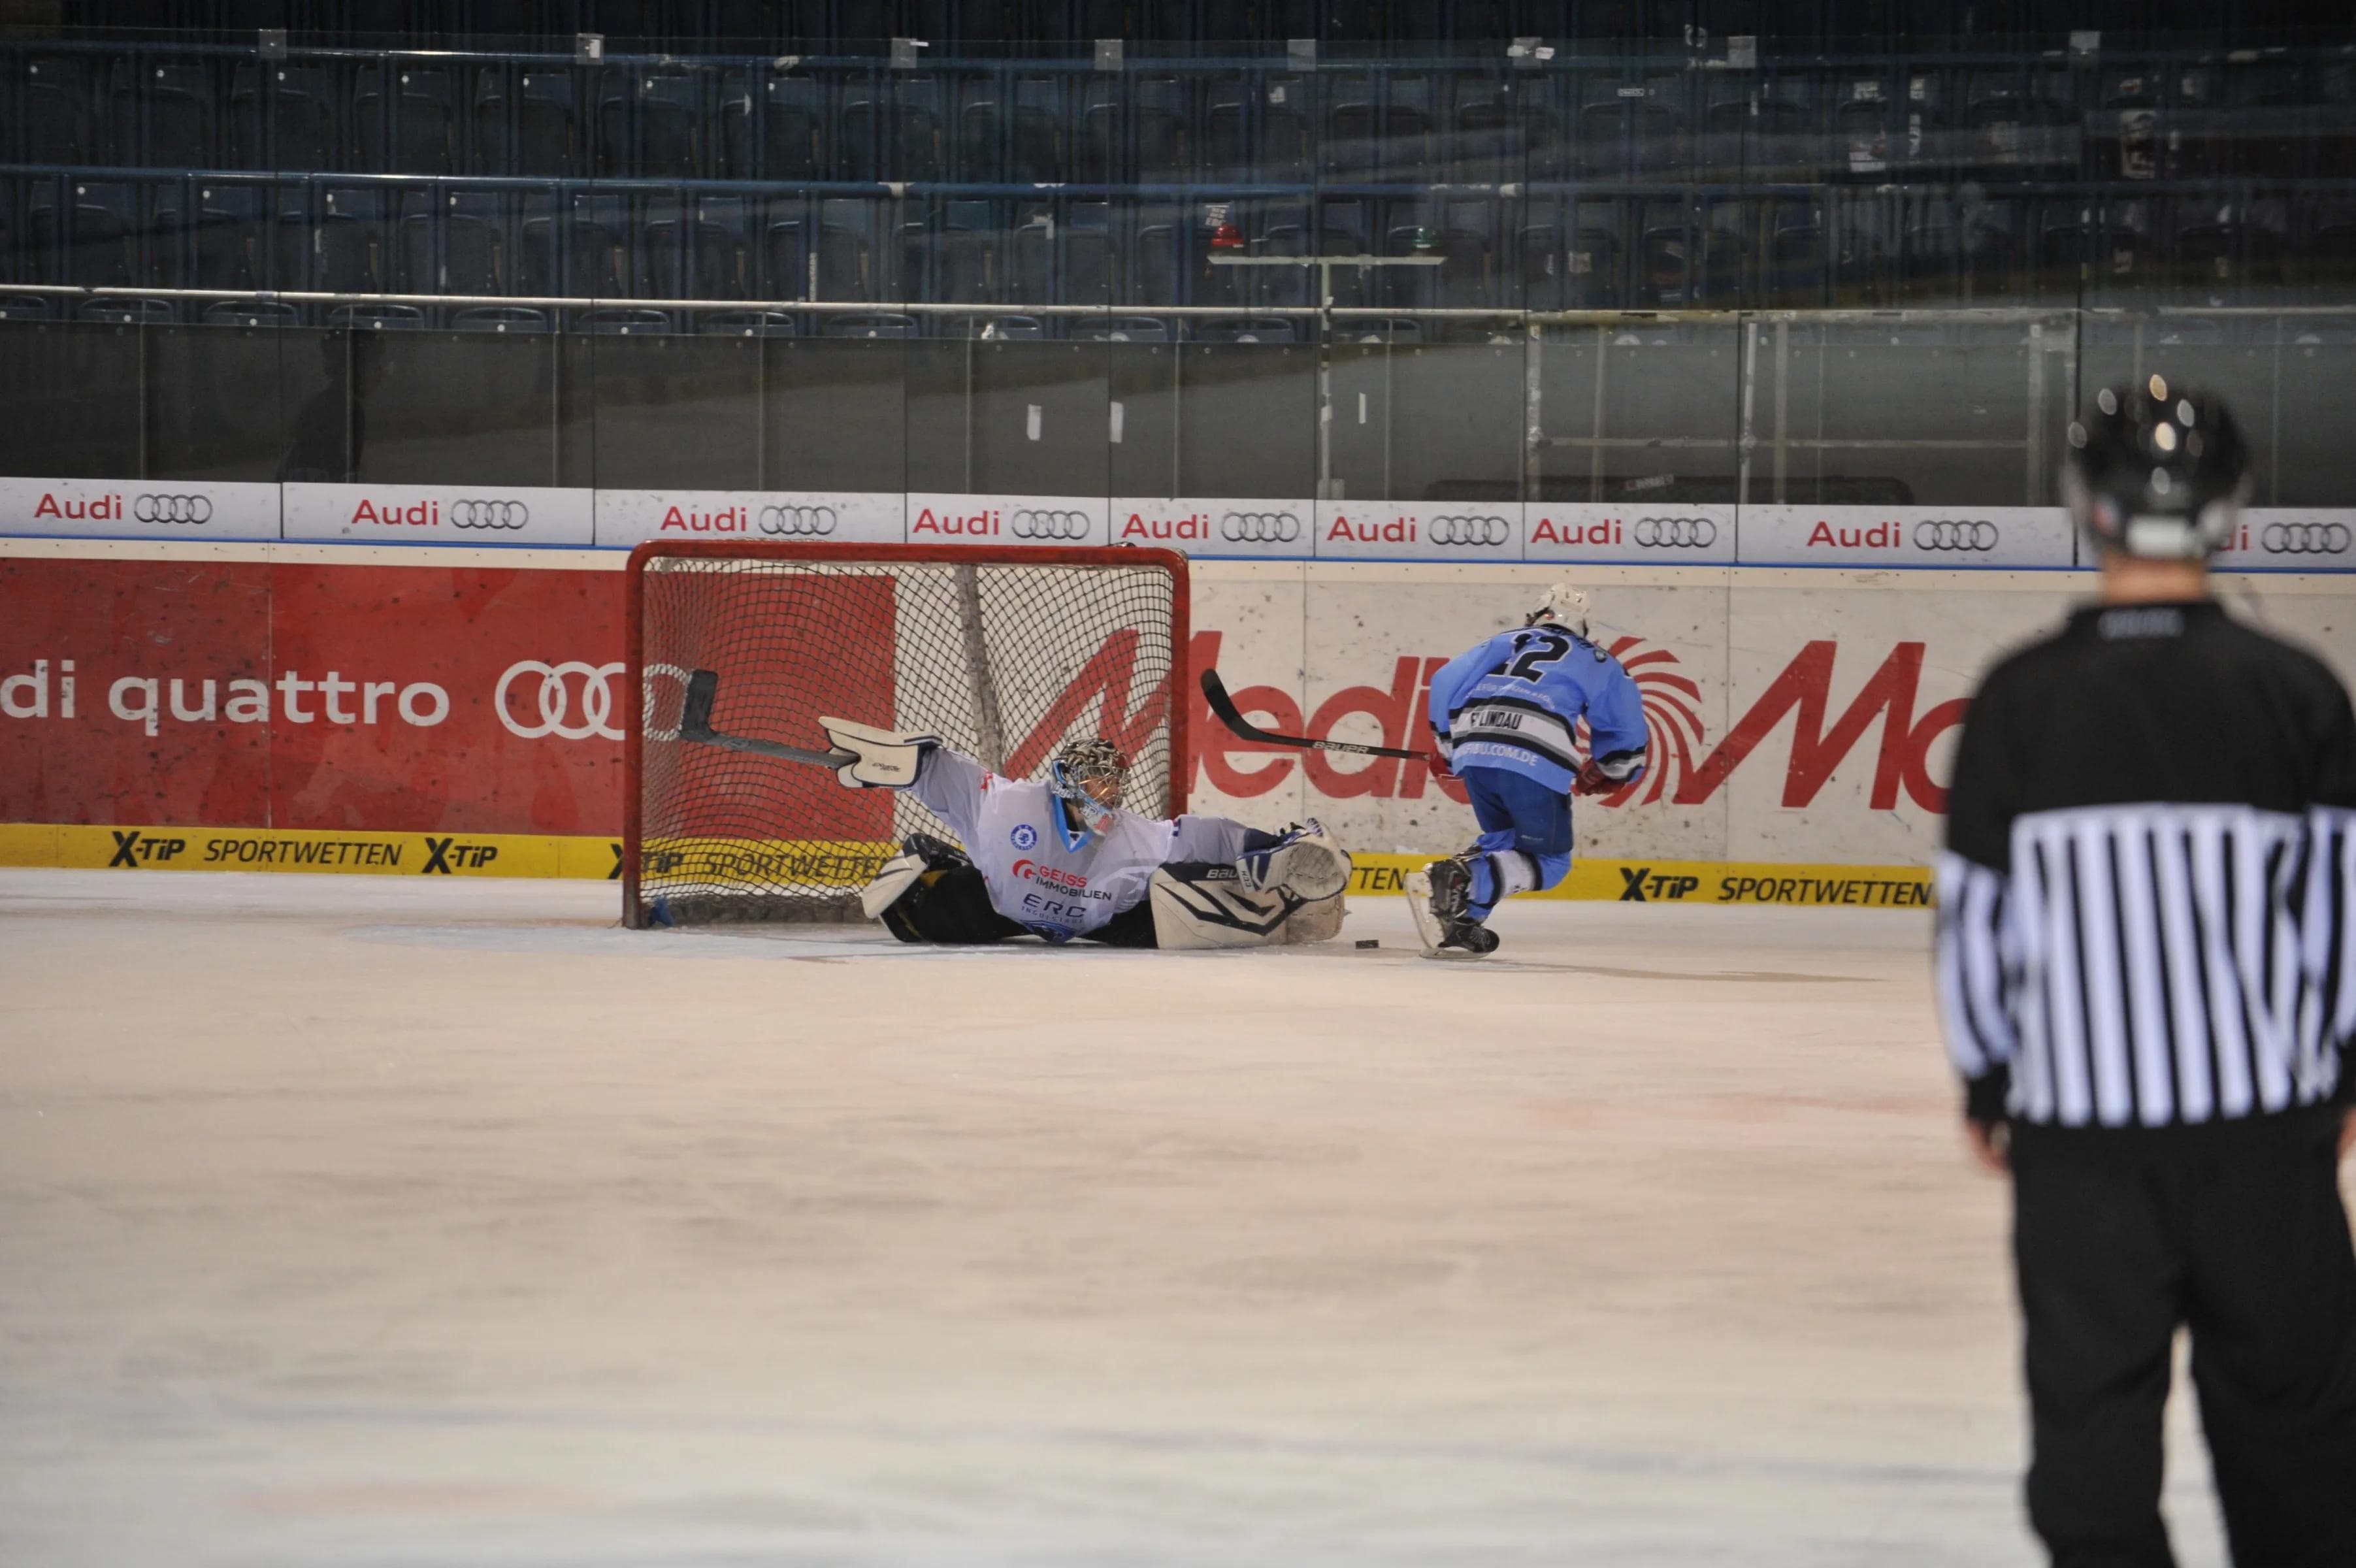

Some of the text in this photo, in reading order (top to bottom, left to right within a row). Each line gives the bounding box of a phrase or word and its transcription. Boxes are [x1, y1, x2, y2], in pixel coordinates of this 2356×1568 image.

[35, 493, 123, 520] Audi
[352, 498, 439, 527] Audi
[661, 506, 747, 532] Audi
[913, 508, 1000, 536] Audi
[1122, 512, 1209, 540] Audi
[1327, 515, 1416, 544] Audi
[1531, 518, 1622, 545] Audi
[1807, 521, 1901, 548] Audi
[108, 670, 450, 736] quattro
[1313, 741, 1370, 755] BAUER
[204, 840, 402, 866] SPORTWETTEN
[1035, 876, 1112, 901] IMMOBILIEN
[1039, 865, 1087, 888] GEISS
[1023, 892, 1087, 918] ERC
[1718, 877, 1933, 906] SPORTWETTEN
